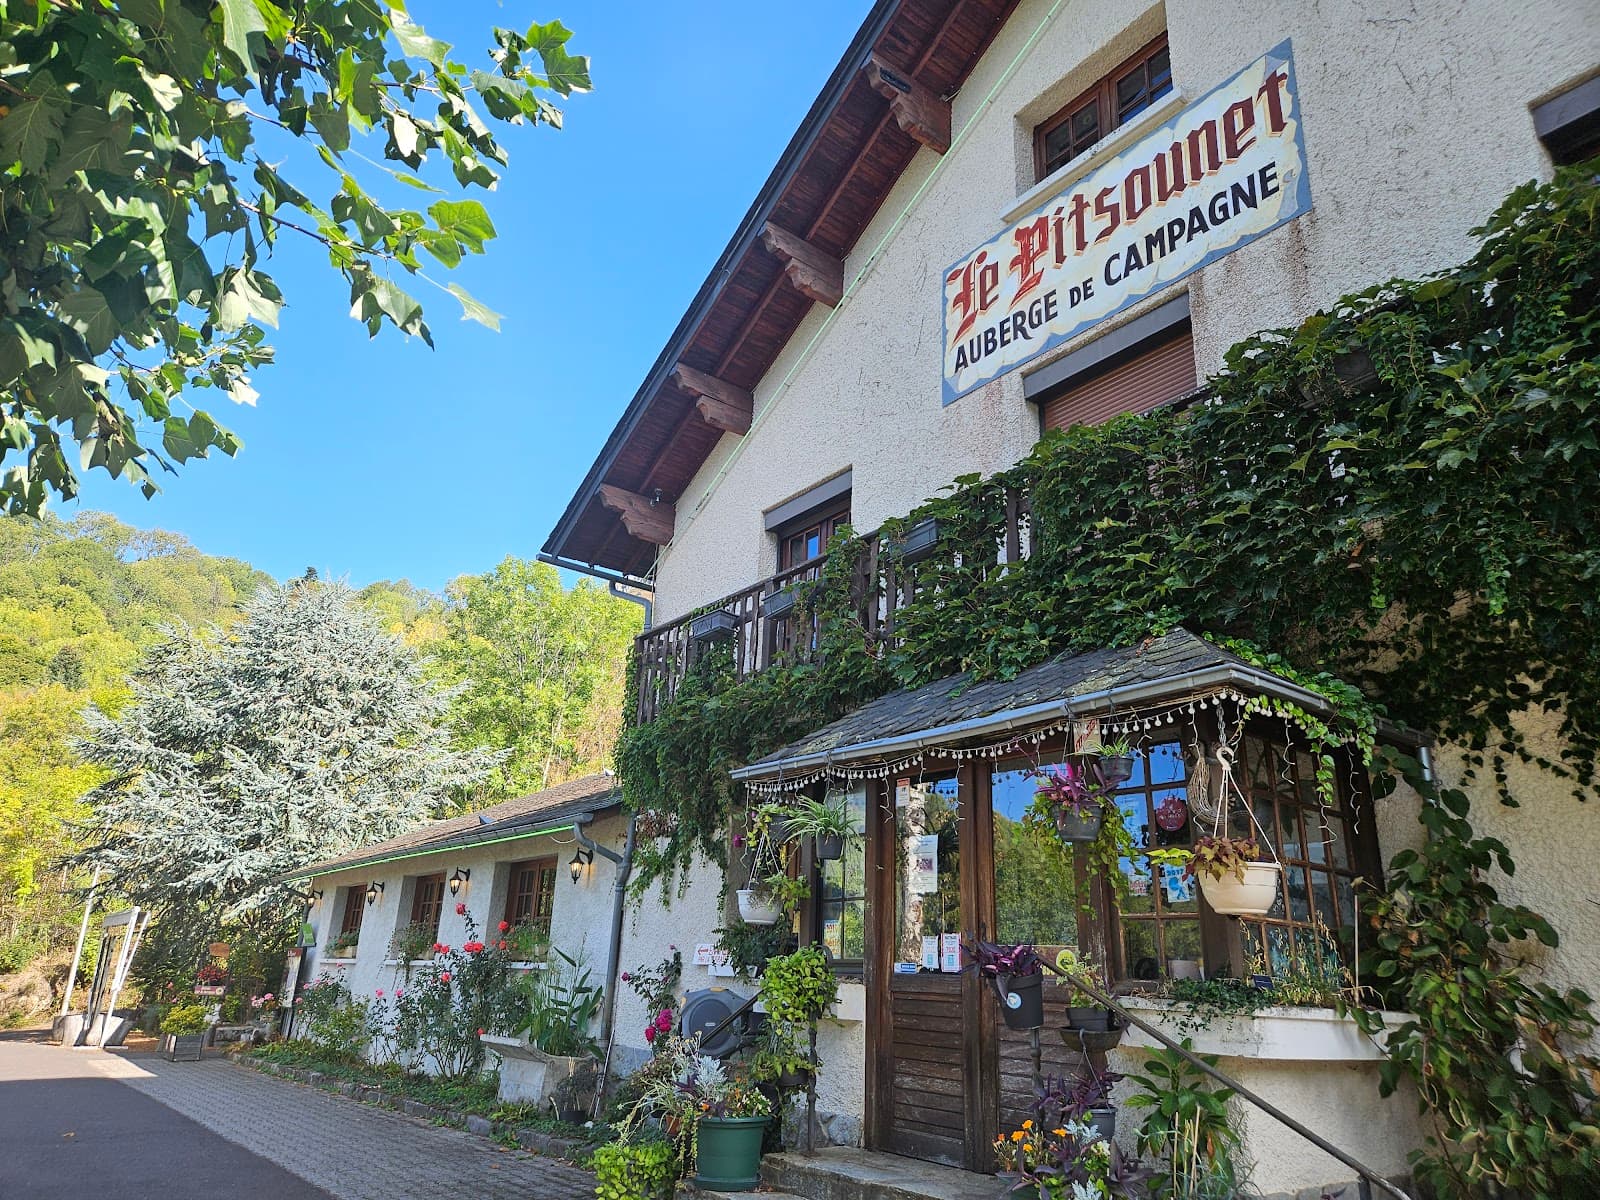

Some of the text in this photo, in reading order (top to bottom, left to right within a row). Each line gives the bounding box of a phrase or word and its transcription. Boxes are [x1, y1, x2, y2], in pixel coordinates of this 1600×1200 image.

[946, 69, 1288, 345] Le Pitsounet
[954, 161, 1280, 374] AUBERGE DE CAMPAGNE
